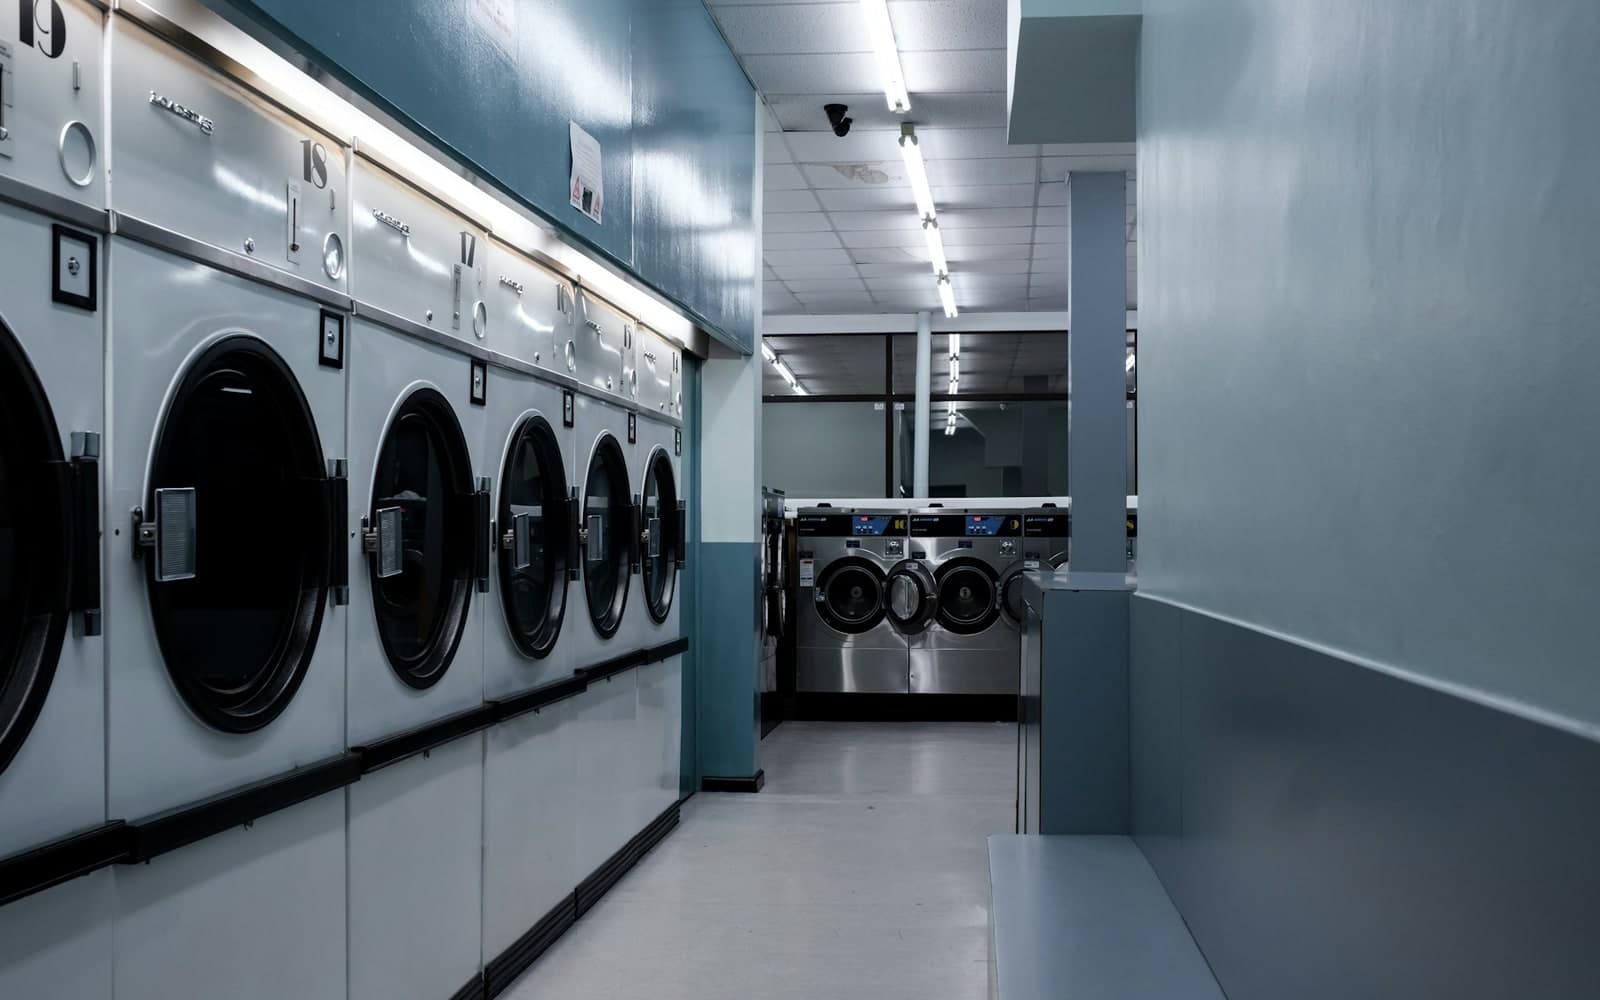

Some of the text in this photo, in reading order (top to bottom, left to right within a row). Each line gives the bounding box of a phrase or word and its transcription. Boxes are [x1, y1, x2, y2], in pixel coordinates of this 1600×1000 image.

[19, 0, 66, 58] 19
[299, 139, 328, 189] 18
[459, 231, 476, 268] 17
